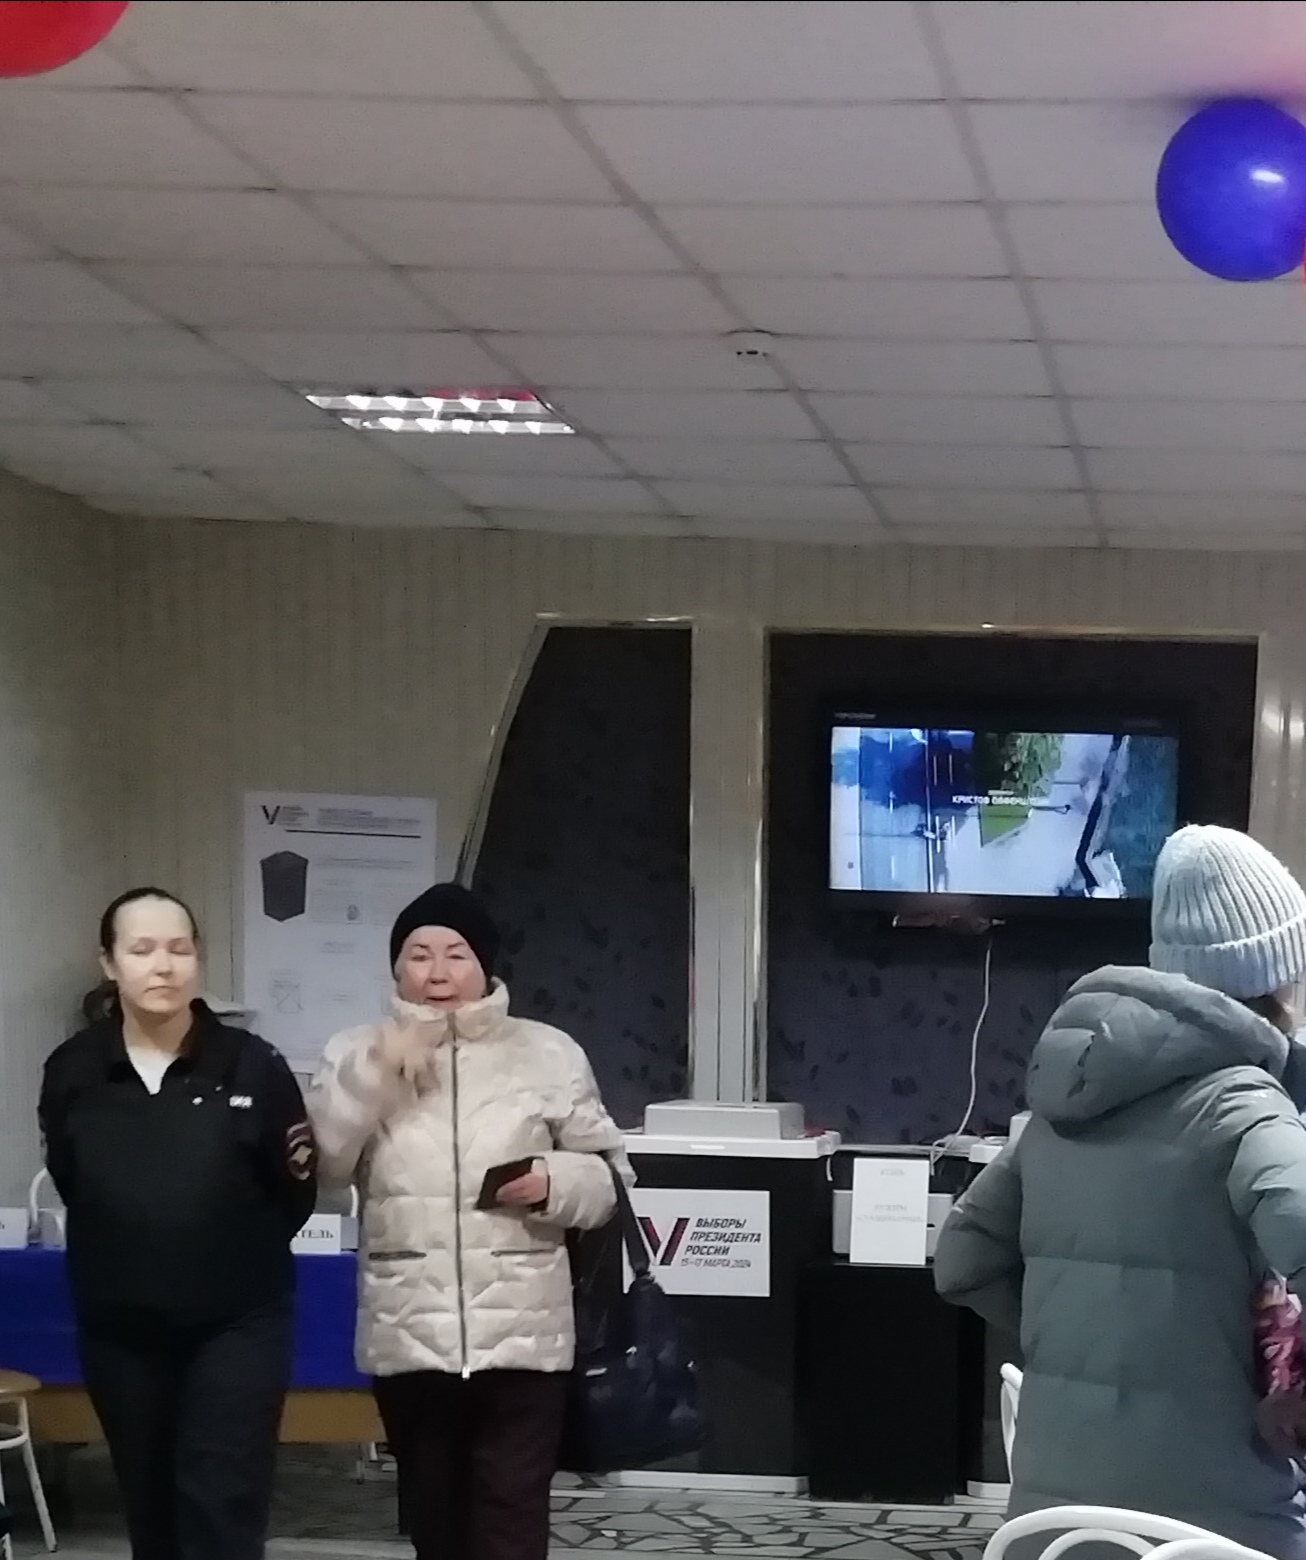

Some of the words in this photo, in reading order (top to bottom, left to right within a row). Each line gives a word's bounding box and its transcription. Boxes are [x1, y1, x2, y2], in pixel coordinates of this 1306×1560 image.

[695, 1217, 747, 1229] ВЫБОРЫ
[690, 1231, 762, 1243] ПРЕЗИДЕНТА
[684, 1245, 731, 1256] РОССИИ
[702, 1258, 731, 1267] МАРТА
